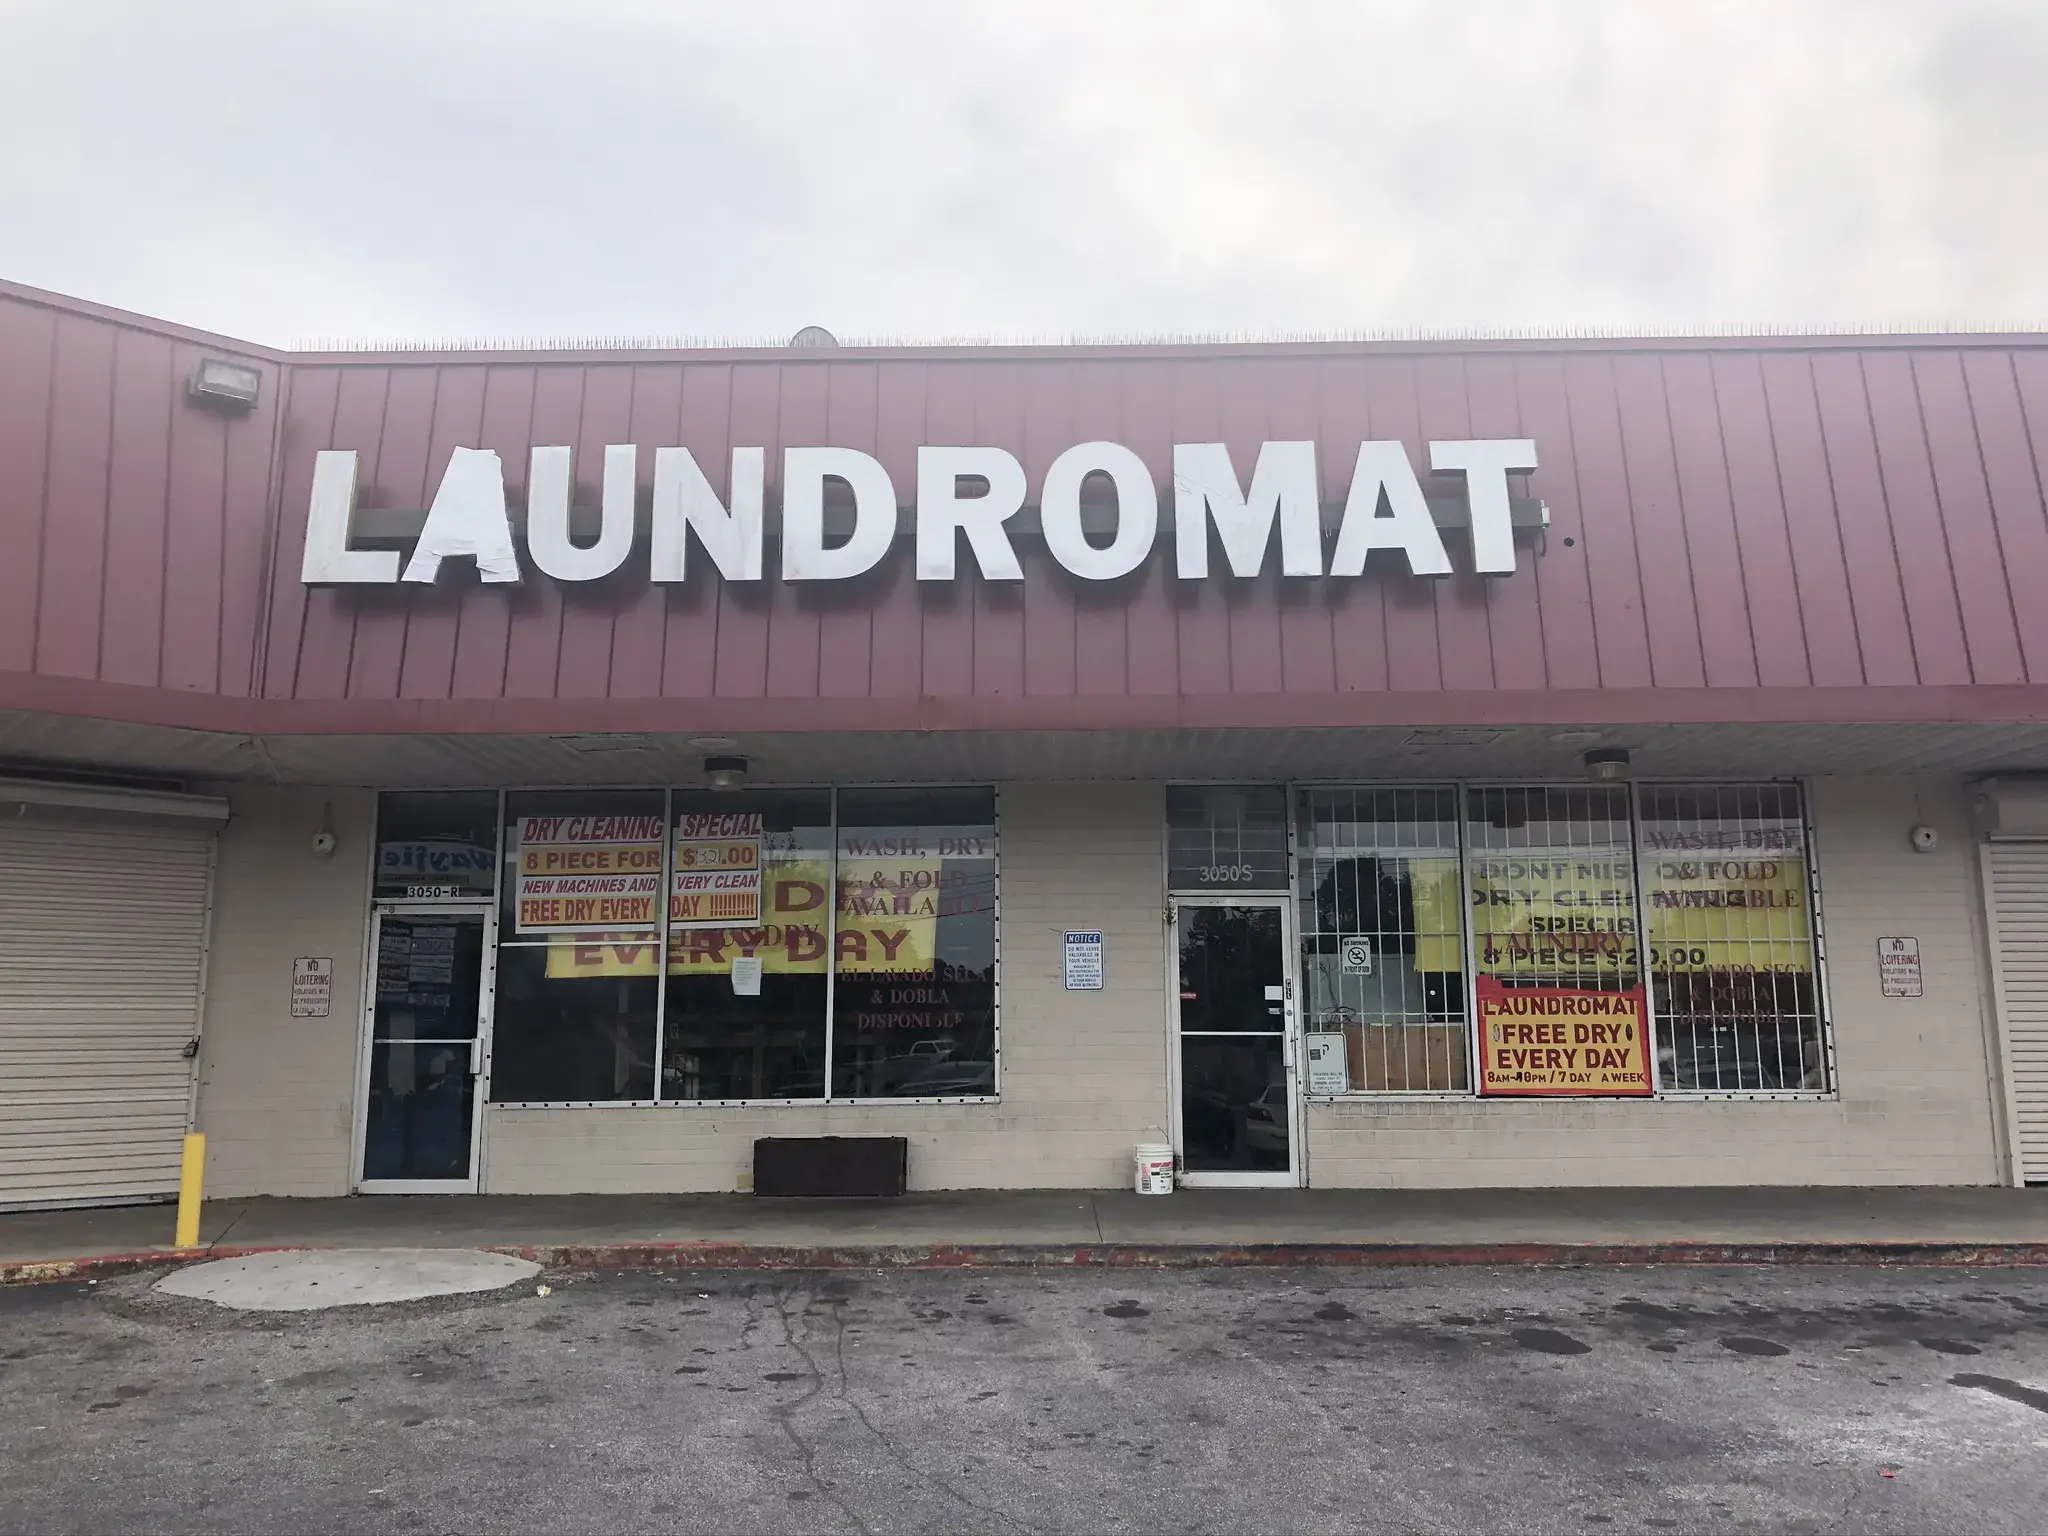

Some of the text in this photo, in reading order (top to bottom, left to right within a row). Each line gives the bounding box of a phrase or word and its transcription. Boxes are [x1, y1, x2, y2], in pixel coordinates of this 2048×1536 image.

[301, 438, 1539, 584] LAUNDROMAT
[523, 814, 763, 842] DRY CLEANING SPECIAL
[845, 837, 987, 859] WASH, DRY
[526, 852, 539, 870] 8
[546, 851, 610, 870] PIECE
[617, 850, 661, 868] FOR
[870, 870, 887, 889] &
[1481, 863, 1568, 880] DONT
[1578, 863, 1631, 880] MIS
[1708, 861, 1778, 880] FOLD
[408, 886, 460, 898] 3050-R
[522, 874, 759, 894] NEW MACHINES AND VERY CLEAN
[521, 899, 560, 922] FREE
[564, 899, 596, 921] DRY
[600, 897, 651, 920] EVERY
[671, 895, 701, 917] DAY
[1528, 916, 1637, 933] SPECIA
[1068, 934, 1099, 943] NOTICE
[1486, 933, 1626, 955] LAUNDRY
[1893, 940, 1904, 951] NO
[307, 960, 319, 971] NO
[1483, 948, 1500, 965] 8
[1510, 948, 1596, 965] PIECE
[1882, 954, 1918, 965] LOITERING
[295, 974, 329, 985] LOITERING
[891, 989, 949, 1003] DOBLA
[1483, 997, 1637, 1016] LAUNDROMAT
[1502, 1023, 1622, 1044] FREE DRY
[1497, 1048, 1630, 1069] EVERY DAY
[1559, 1071, 1567, 1083] 7
[1570, 1073, 1592, 1083] DAY
[1601, 1073, 1609, 1083] A
[1610, 1072, 1645, 1083] WEEK
